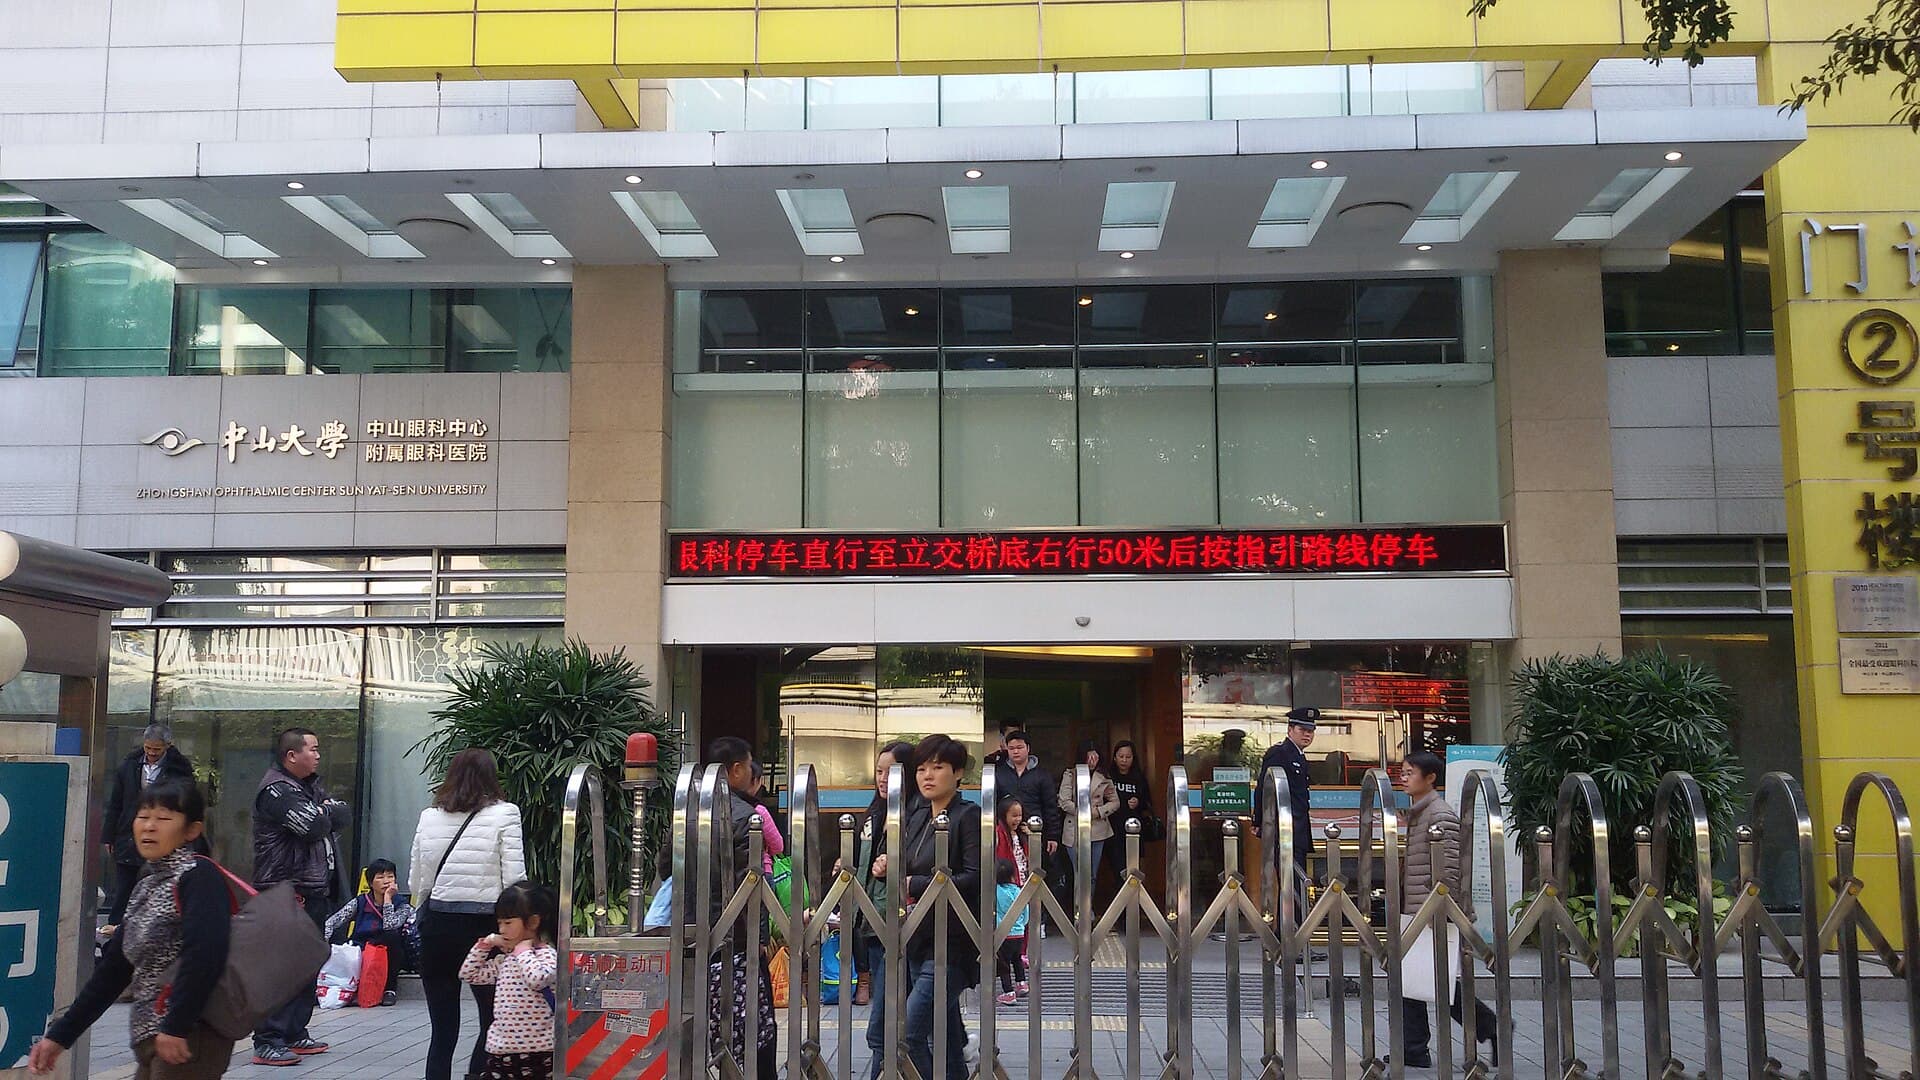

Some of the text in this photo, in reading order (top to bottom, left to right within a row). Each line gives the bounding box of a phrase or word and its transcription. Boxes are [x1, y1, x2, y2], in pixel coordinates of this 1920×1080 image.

[366, 418, 488, 438] 中山眼科中心
[366, 443, 488, 462] 附属眼科医院
[136, 484, 487, 499] ZHONGSHAN OPHTHALMIC CENTER SUN YAT-SEN UNIVERSITY
